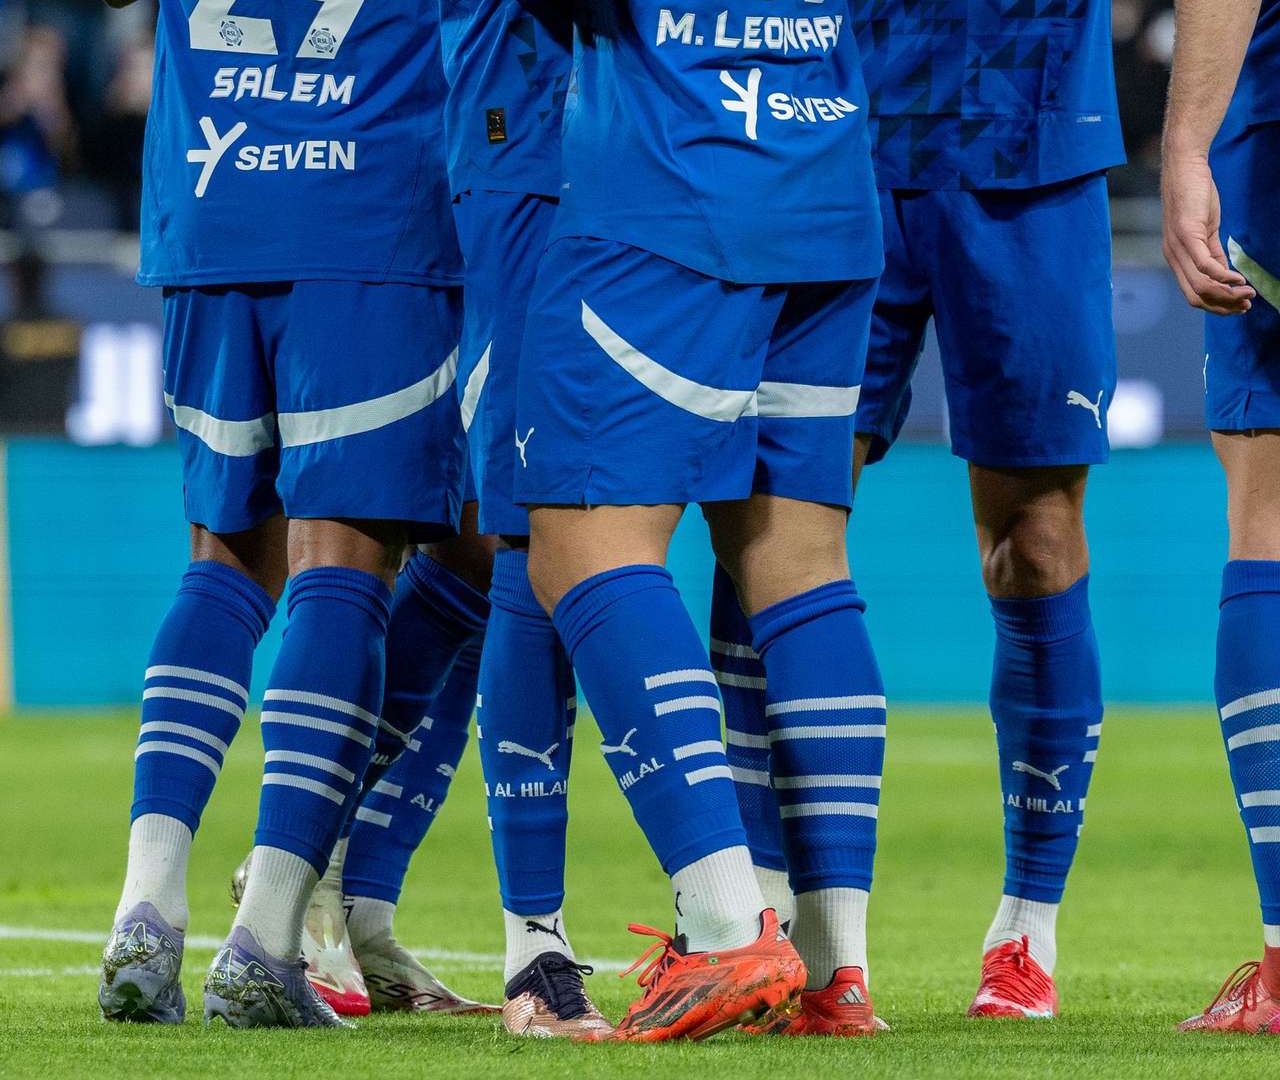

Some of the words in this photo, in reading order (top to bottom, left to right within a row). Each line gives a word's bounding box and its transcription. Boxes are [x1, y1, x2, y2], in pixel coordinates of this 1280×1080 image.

[656, 9, 704, 47] M.
[209, 64, 355, 107] SALEM
[235, 141, 355, 171] SEVEN
[494, 782, 516, 797] AL
[1007, 794, 1023, 809] AL
[1027, 797, 1074, 813] HILAL
